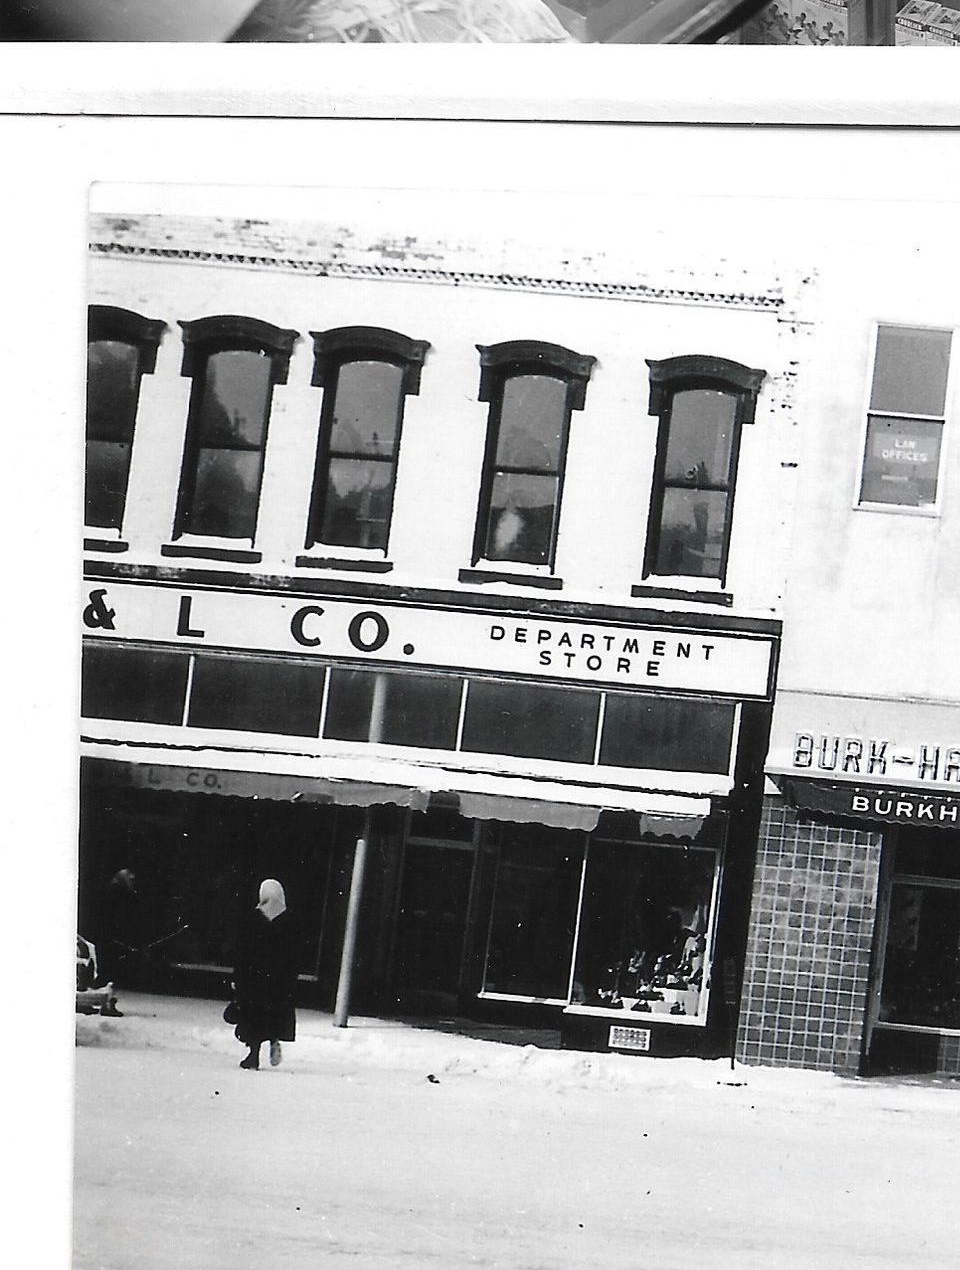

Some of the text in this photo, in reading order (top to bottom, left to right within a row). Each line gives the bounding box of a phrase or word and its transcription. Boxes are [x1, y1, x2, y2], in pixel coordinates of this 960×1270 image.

[83, 588, 416, 656] & L CO.
[489, 624, 715, 661] DEPARTMENT
[538, 650, 661, 677] STORE
[186, 771, 222, 789] CO.
